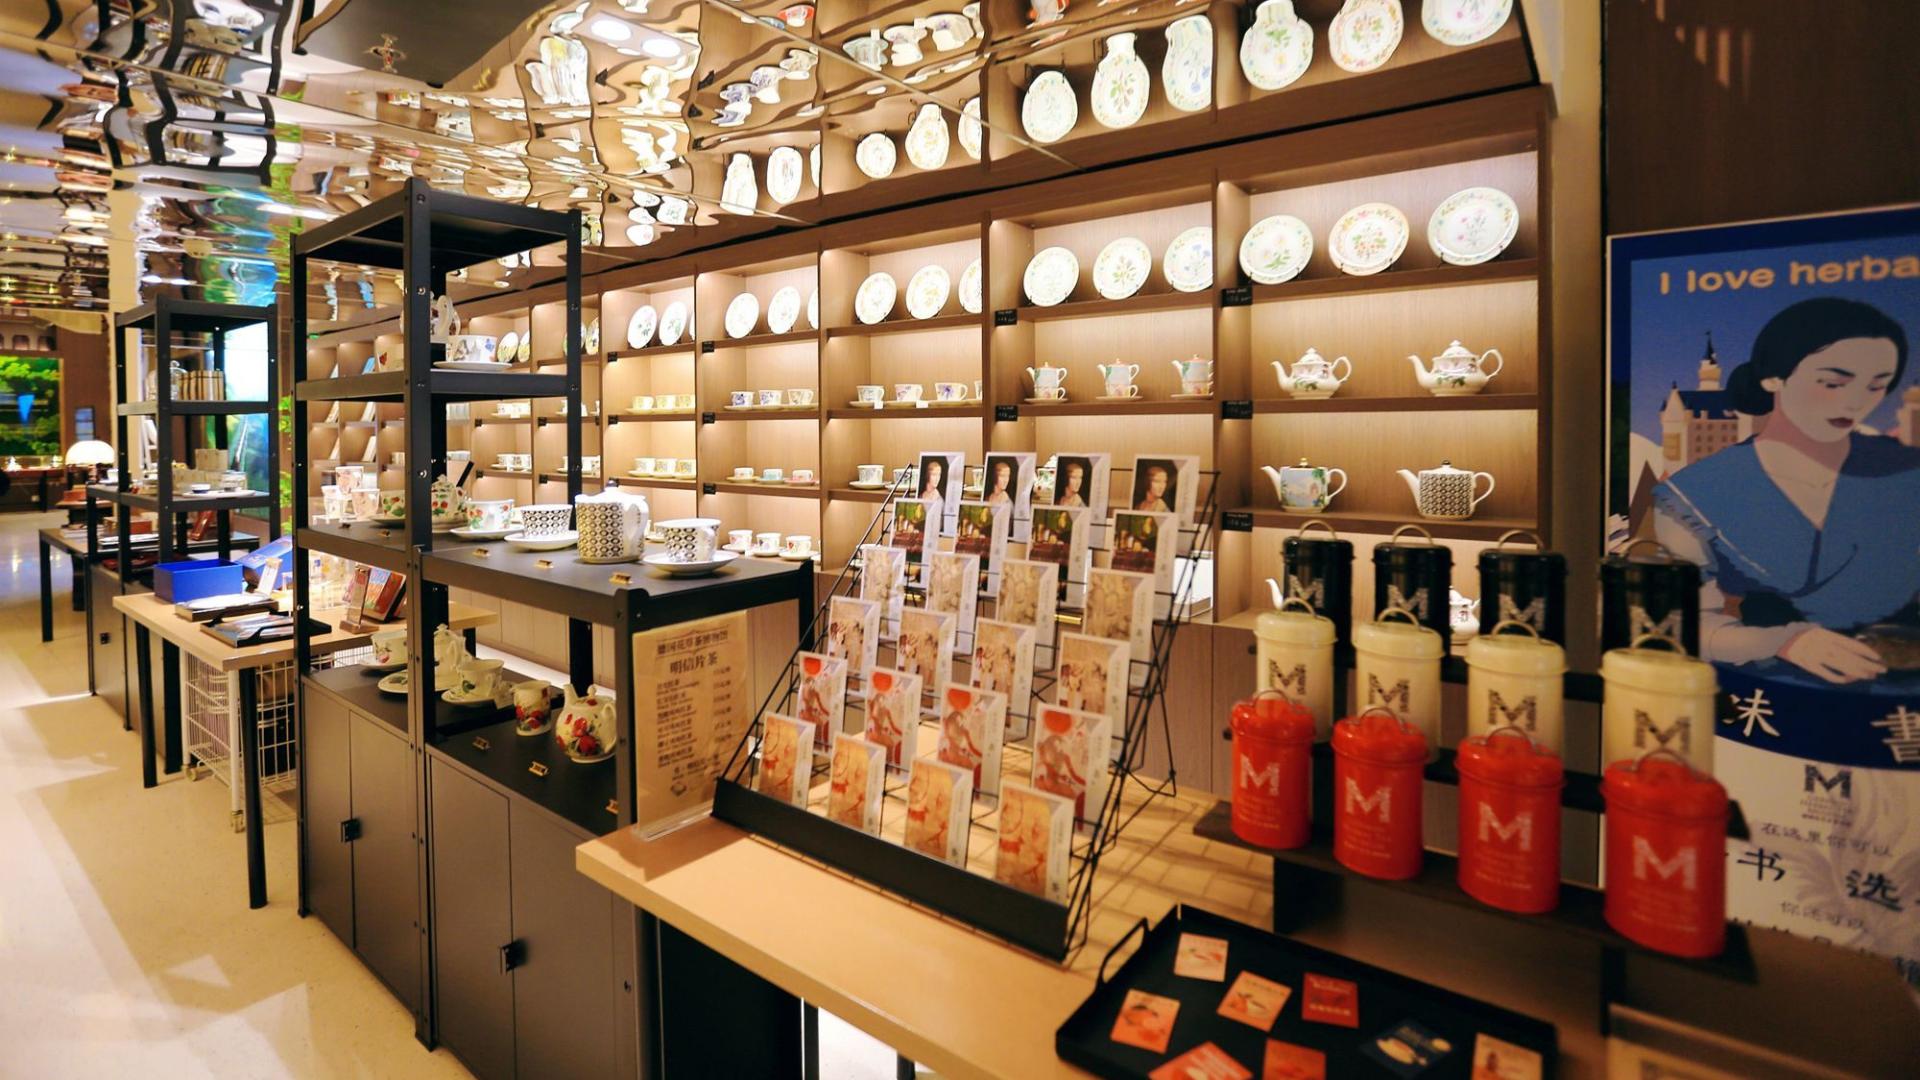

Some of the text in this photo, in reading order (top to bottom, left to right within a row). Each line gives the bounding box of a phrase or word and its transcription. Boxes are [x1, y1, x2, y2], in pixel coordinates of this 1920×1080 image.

[1660, 271, 1670, 295] I
[1686, 268, 1775, 294] love
[1289, 574, 1325, 608] M
[1387, 584, 1429, 620] M
[1498, 593, 1546, 632] M
[1629, 604, 1683, 650] M
[1268, 659, 1307, 695] M
[1368, 673, 1410, 713] M
[1488, 688, 1537, 732] M
[1634, 708, 1692, 753] M
[1239, 753, 1281, 797] M
[1804, 764, 1852, 799] M
[1345, 776, 1393, 823] M
[1478, 801, 1534, 852] M
[1632, 834, 1697, 890] M
